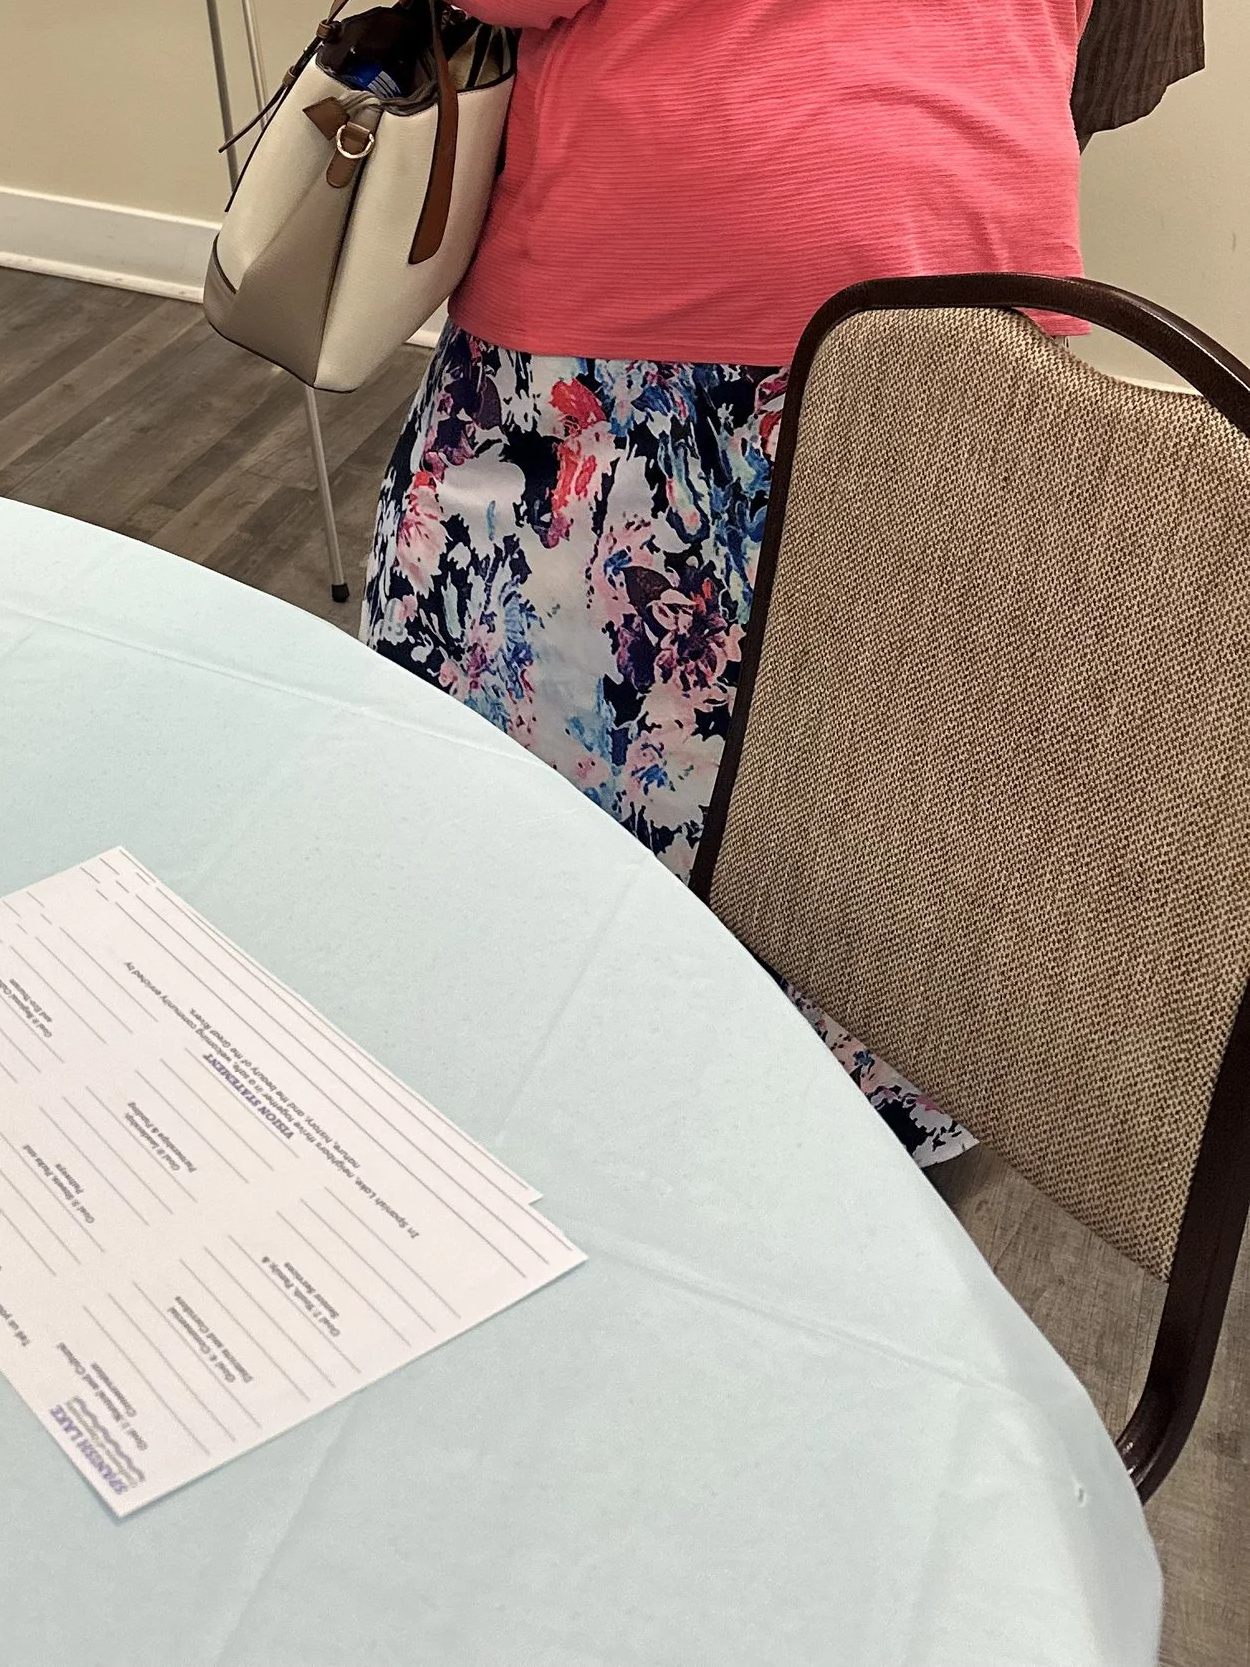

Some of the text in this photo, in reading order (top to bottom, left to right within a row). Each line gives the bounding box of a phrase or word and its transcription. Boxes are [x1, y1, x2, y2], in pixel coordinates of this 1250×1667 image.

[202, 1053, 294, 1140] VISION STATEMENT
[49, 1404, 128, 1495] SPANISH LAKE
